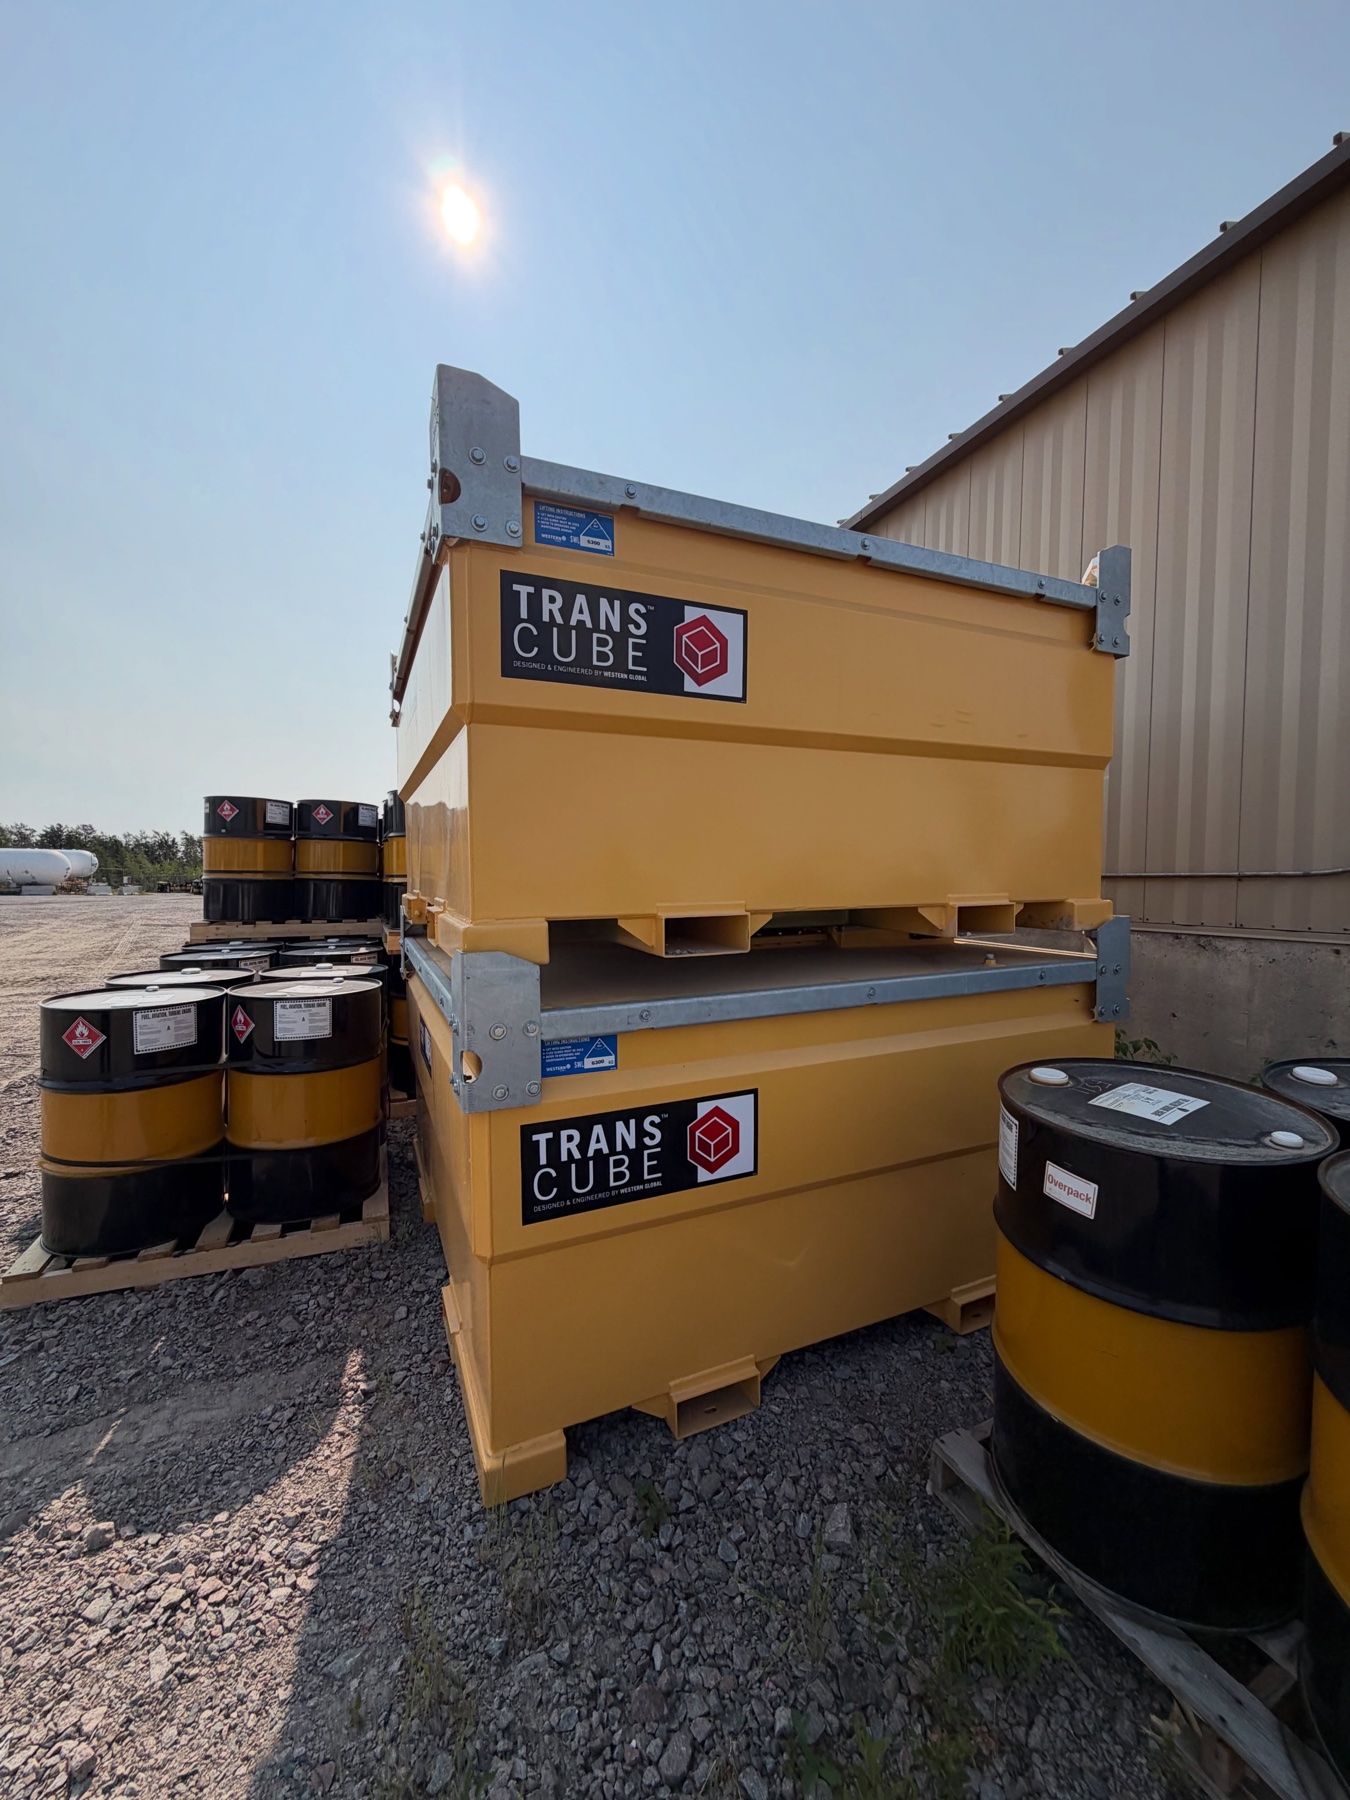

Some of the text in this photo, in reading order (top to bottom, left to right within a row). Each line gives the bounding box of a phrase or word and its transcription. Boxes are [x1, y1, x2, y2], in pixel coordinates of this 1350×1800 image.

[513, 622, 647, 671] CUBE
[513, 660, 546, 670] DESIGNED
[554, 664, 593, 676] ENGINEERED
[603, 671, 628, 680] WESTERN
[629, 674, 648, 682] GLOBAL
[533, 1147, 662, 1201] CUBE
[1047, 1173, 1092, 1205] Overpack
[533, 1200, 565, 1212] DESIGNED
[572, 1191, 610, 1204] ENGINEERED
[620, 1184, 644, 1194] WESTERN
[645, 1180, 662, 1189] GLOBAL
